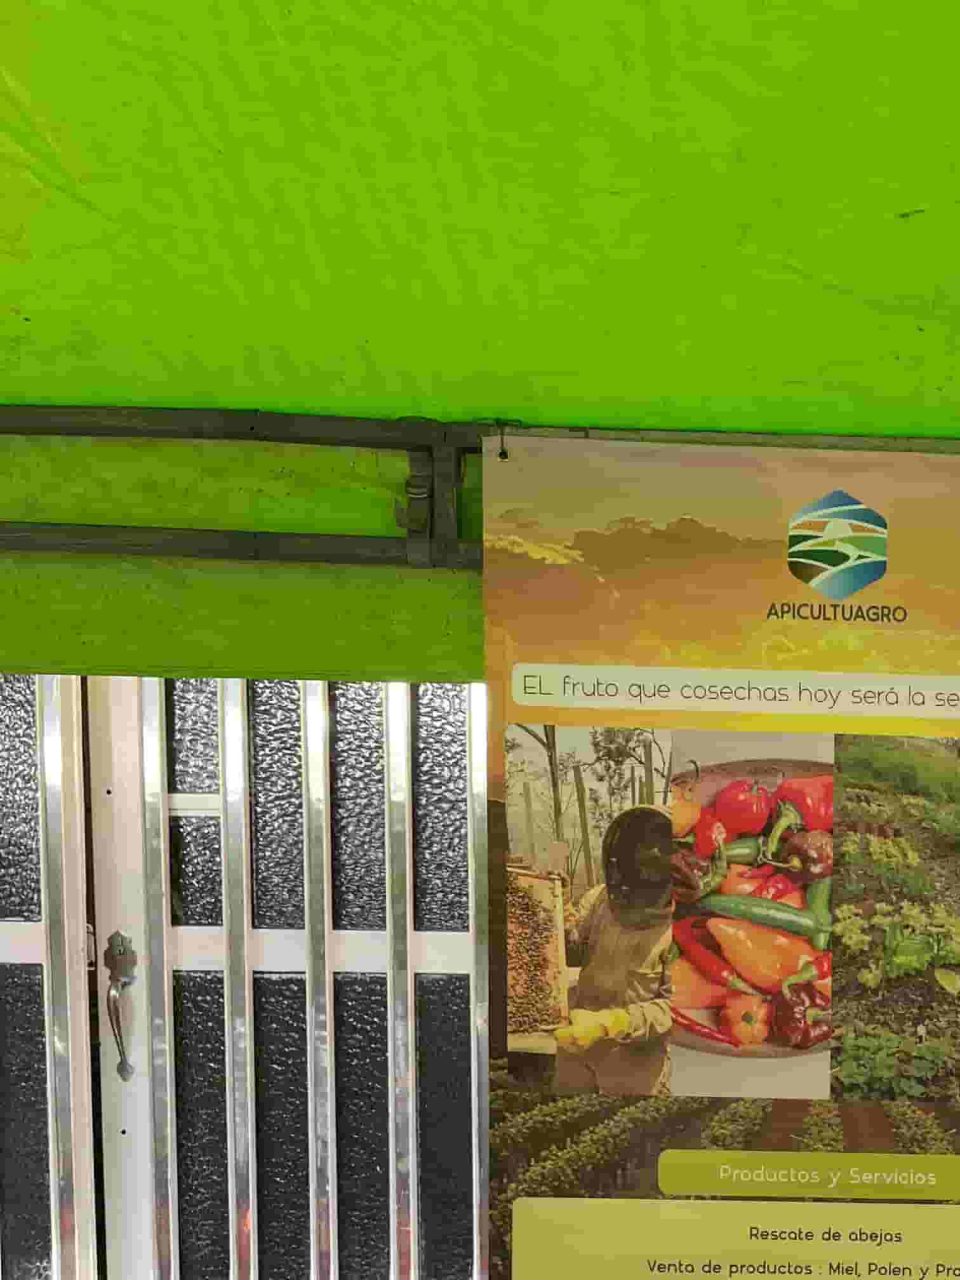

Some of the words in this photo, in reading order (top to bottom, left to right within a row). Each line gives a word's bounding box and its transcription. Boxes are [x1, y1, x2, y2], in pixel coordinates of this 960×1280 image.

[767, 602, 907, 623] APICULTUAGRO
[523, 674, 553, 696] EL
[563, 676, 619, 698] fruto
[628, 680, 671, 706] que
[680, 679, 789, 703] cosechas
[798, 681, 841, 709] hoy
[851, 683, 899, 706] será
[907, 685, 926, 707] la
[719, 1164, 820, 1185] Productos
[828, 1171, 840, 1188] y
[849, 1167, 937, 1186] Servicios
[749, 1227, 815, 1242] Rescate
[822, 1227, 842, 1242] de
[848, 1228, 903, 1246] abejas
[647, 1260, 696, 1275] Venta
[702, 1261, 723, 1276] de
[729, 1261, 812, 1280] productos
[829, 1263, 861, 1279] Miel,
[868, 1263, 912, 1279] Polen
[919, 1267, 929, 1280] y
